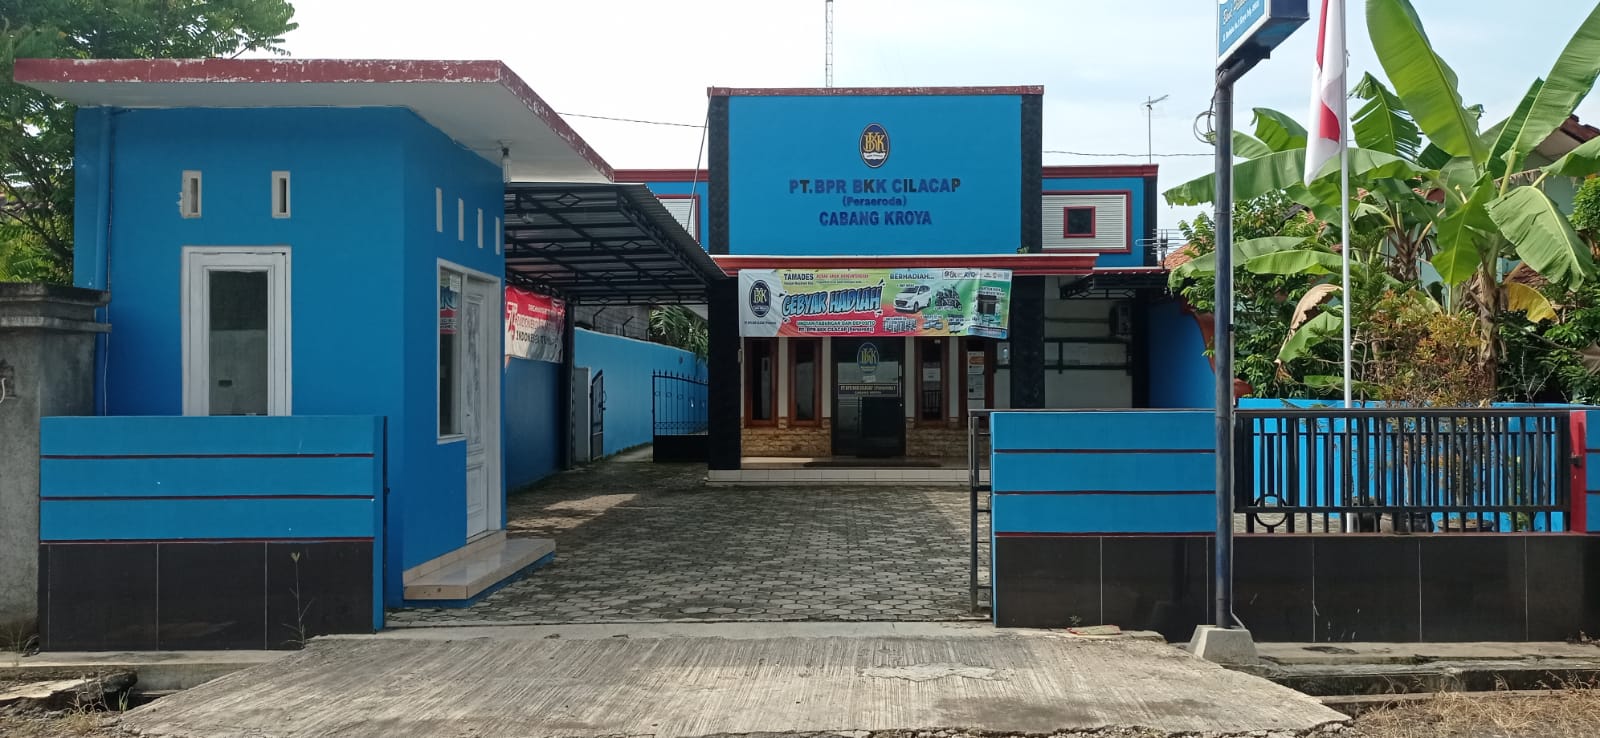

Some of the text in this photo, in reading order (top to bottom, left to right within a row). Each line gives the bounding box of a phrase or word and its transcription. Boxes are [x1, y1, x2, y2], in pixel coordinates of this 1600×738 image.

[853, 178, 887, 193] BKK
[892, 178, 961, 193] CILACAP
[819, 210, 932, 226] CABANG KROYA
[783, 273, 814, 281] TAMADES
[782, 286, 882, 316] GEBYAR HADIAH
